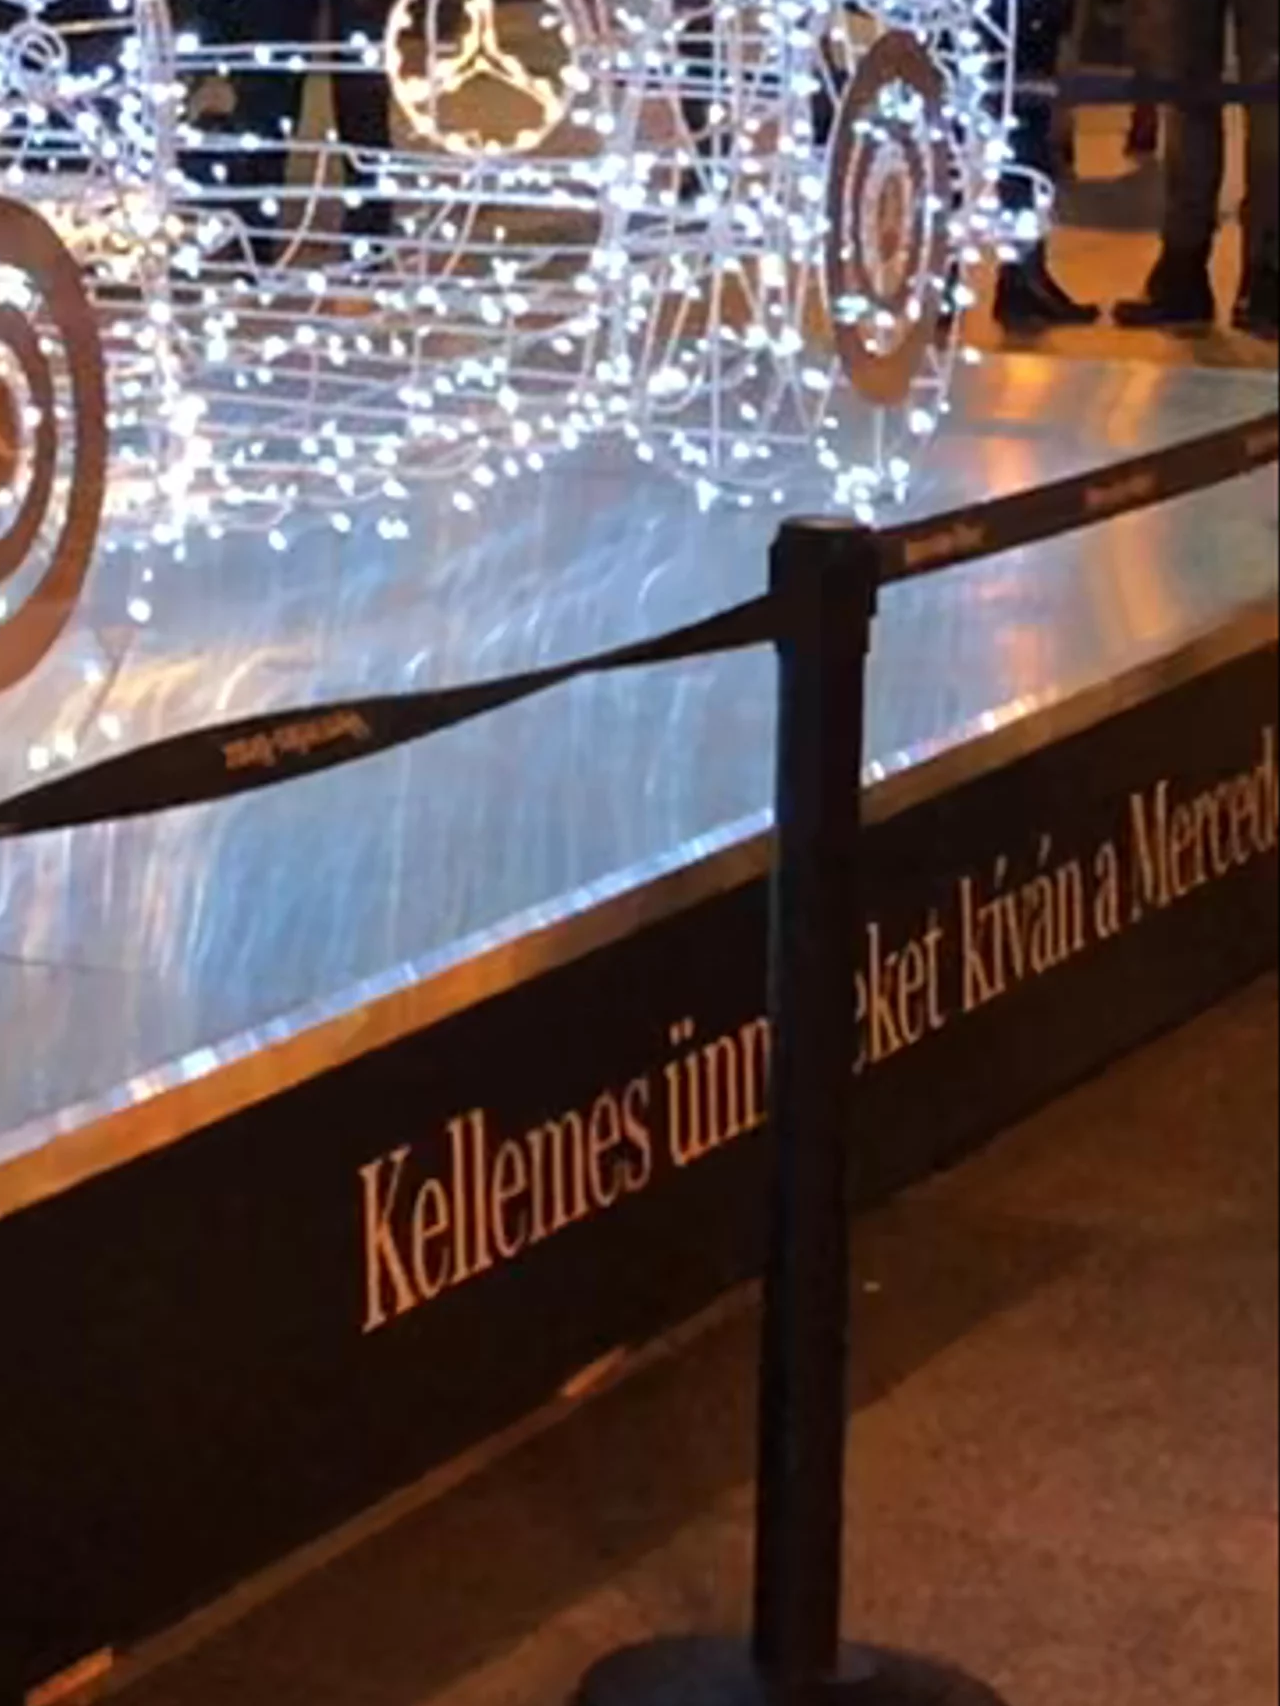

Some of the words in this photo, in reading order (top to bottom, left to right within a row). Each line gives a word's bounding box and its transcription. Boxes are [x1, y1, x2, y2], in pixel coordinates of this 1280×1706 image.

[358, 1077, 652, 1335] Kellemes
[959, 833, 1086, 1013] kíván
[1093, 839, 1121, 940] a
